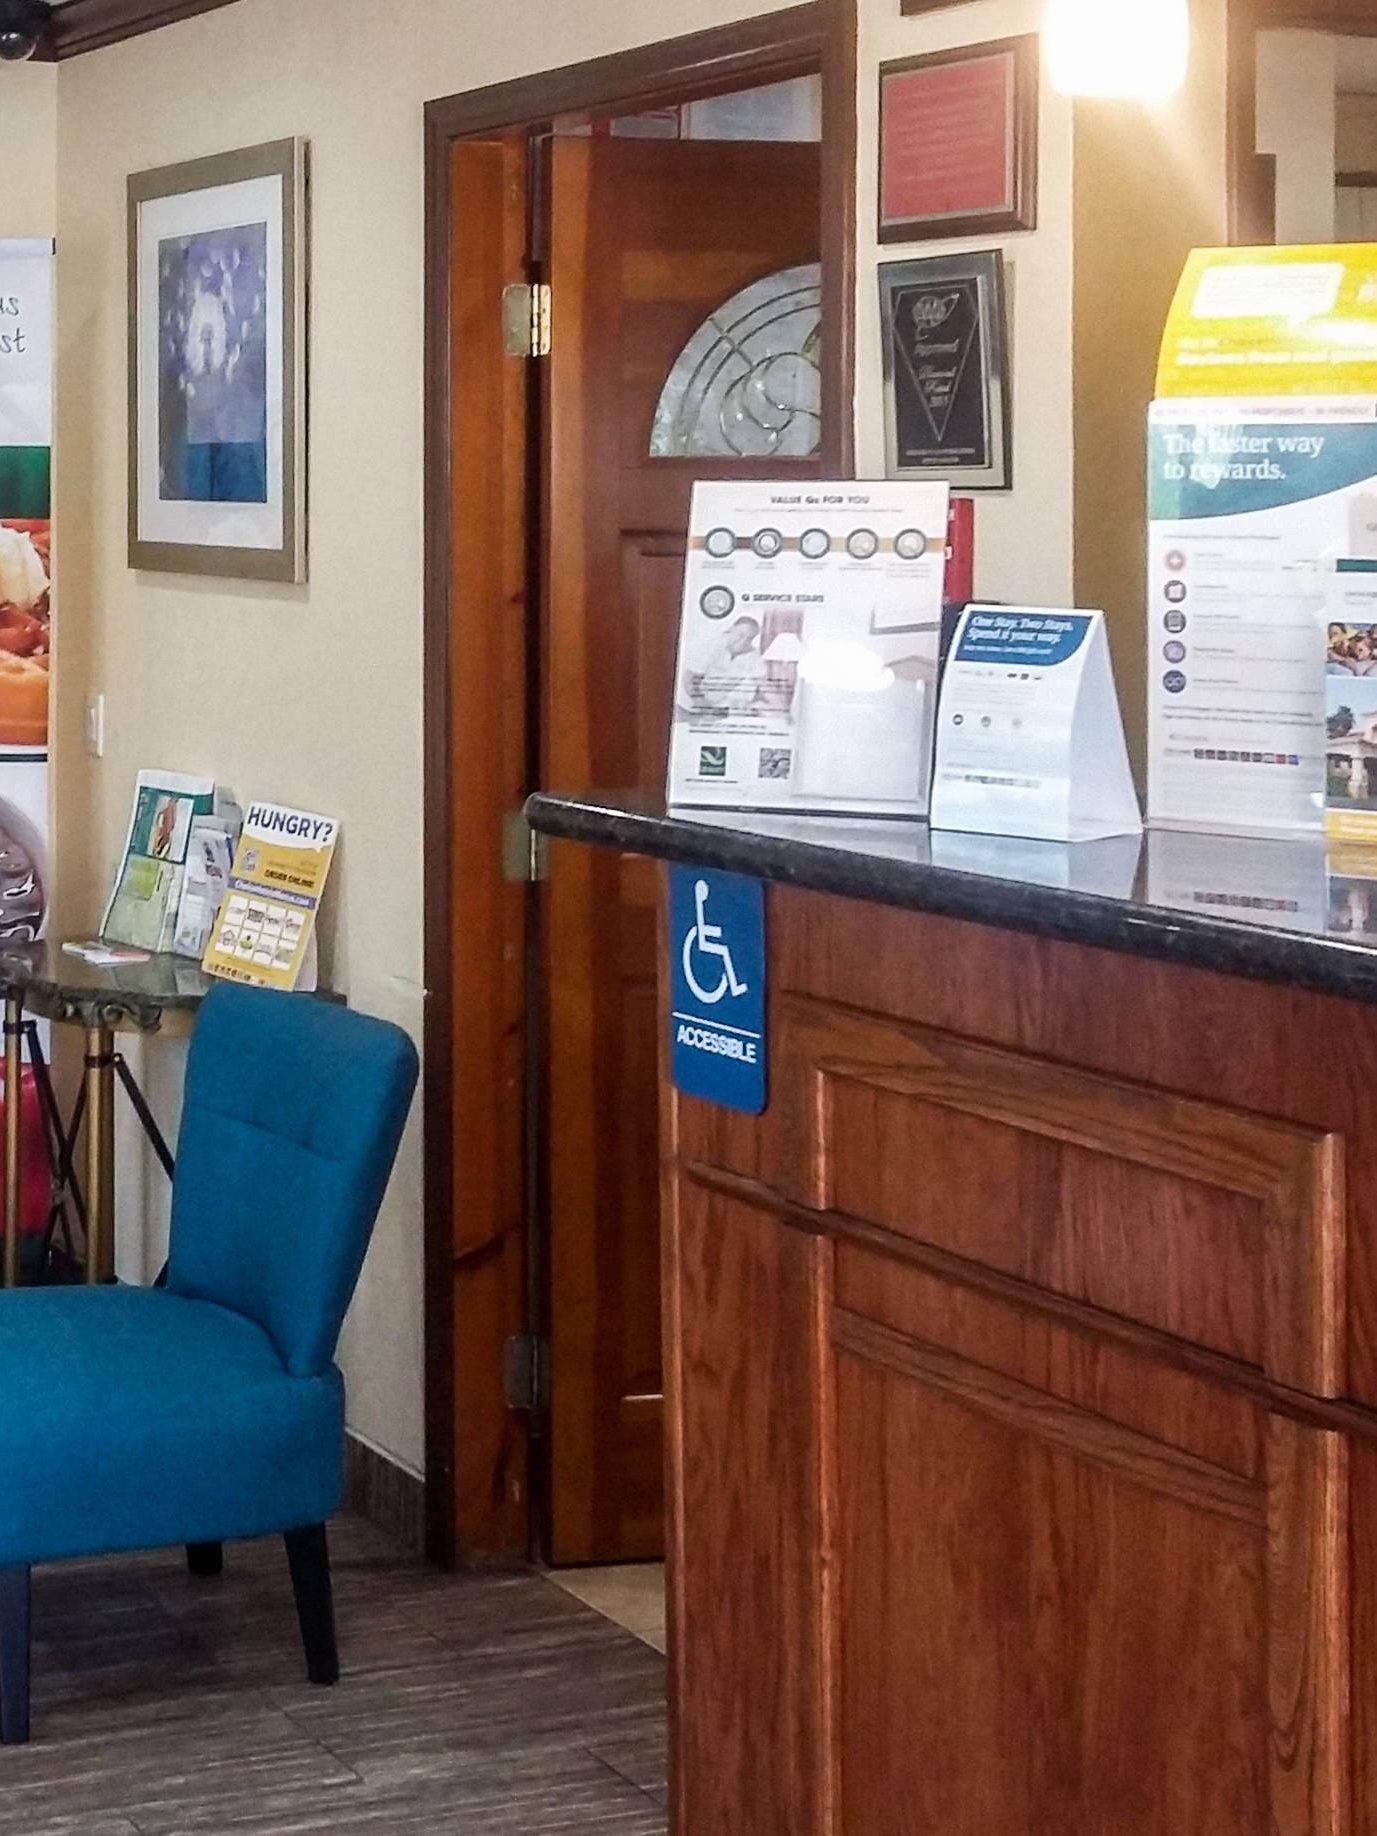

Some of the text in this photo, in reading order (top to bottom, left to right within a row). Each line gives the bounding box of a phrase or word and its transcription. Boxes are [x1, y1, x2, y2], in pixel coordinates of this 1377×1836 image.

[1162, 433, 1206, 454] The
[1277, 436, 1325, 458] way
[1163, 461, 1184, 479] to
[247, 806, 333, 843] HUNGRY?
[676, 1024, 757, 1064] ACCESSIBLE
